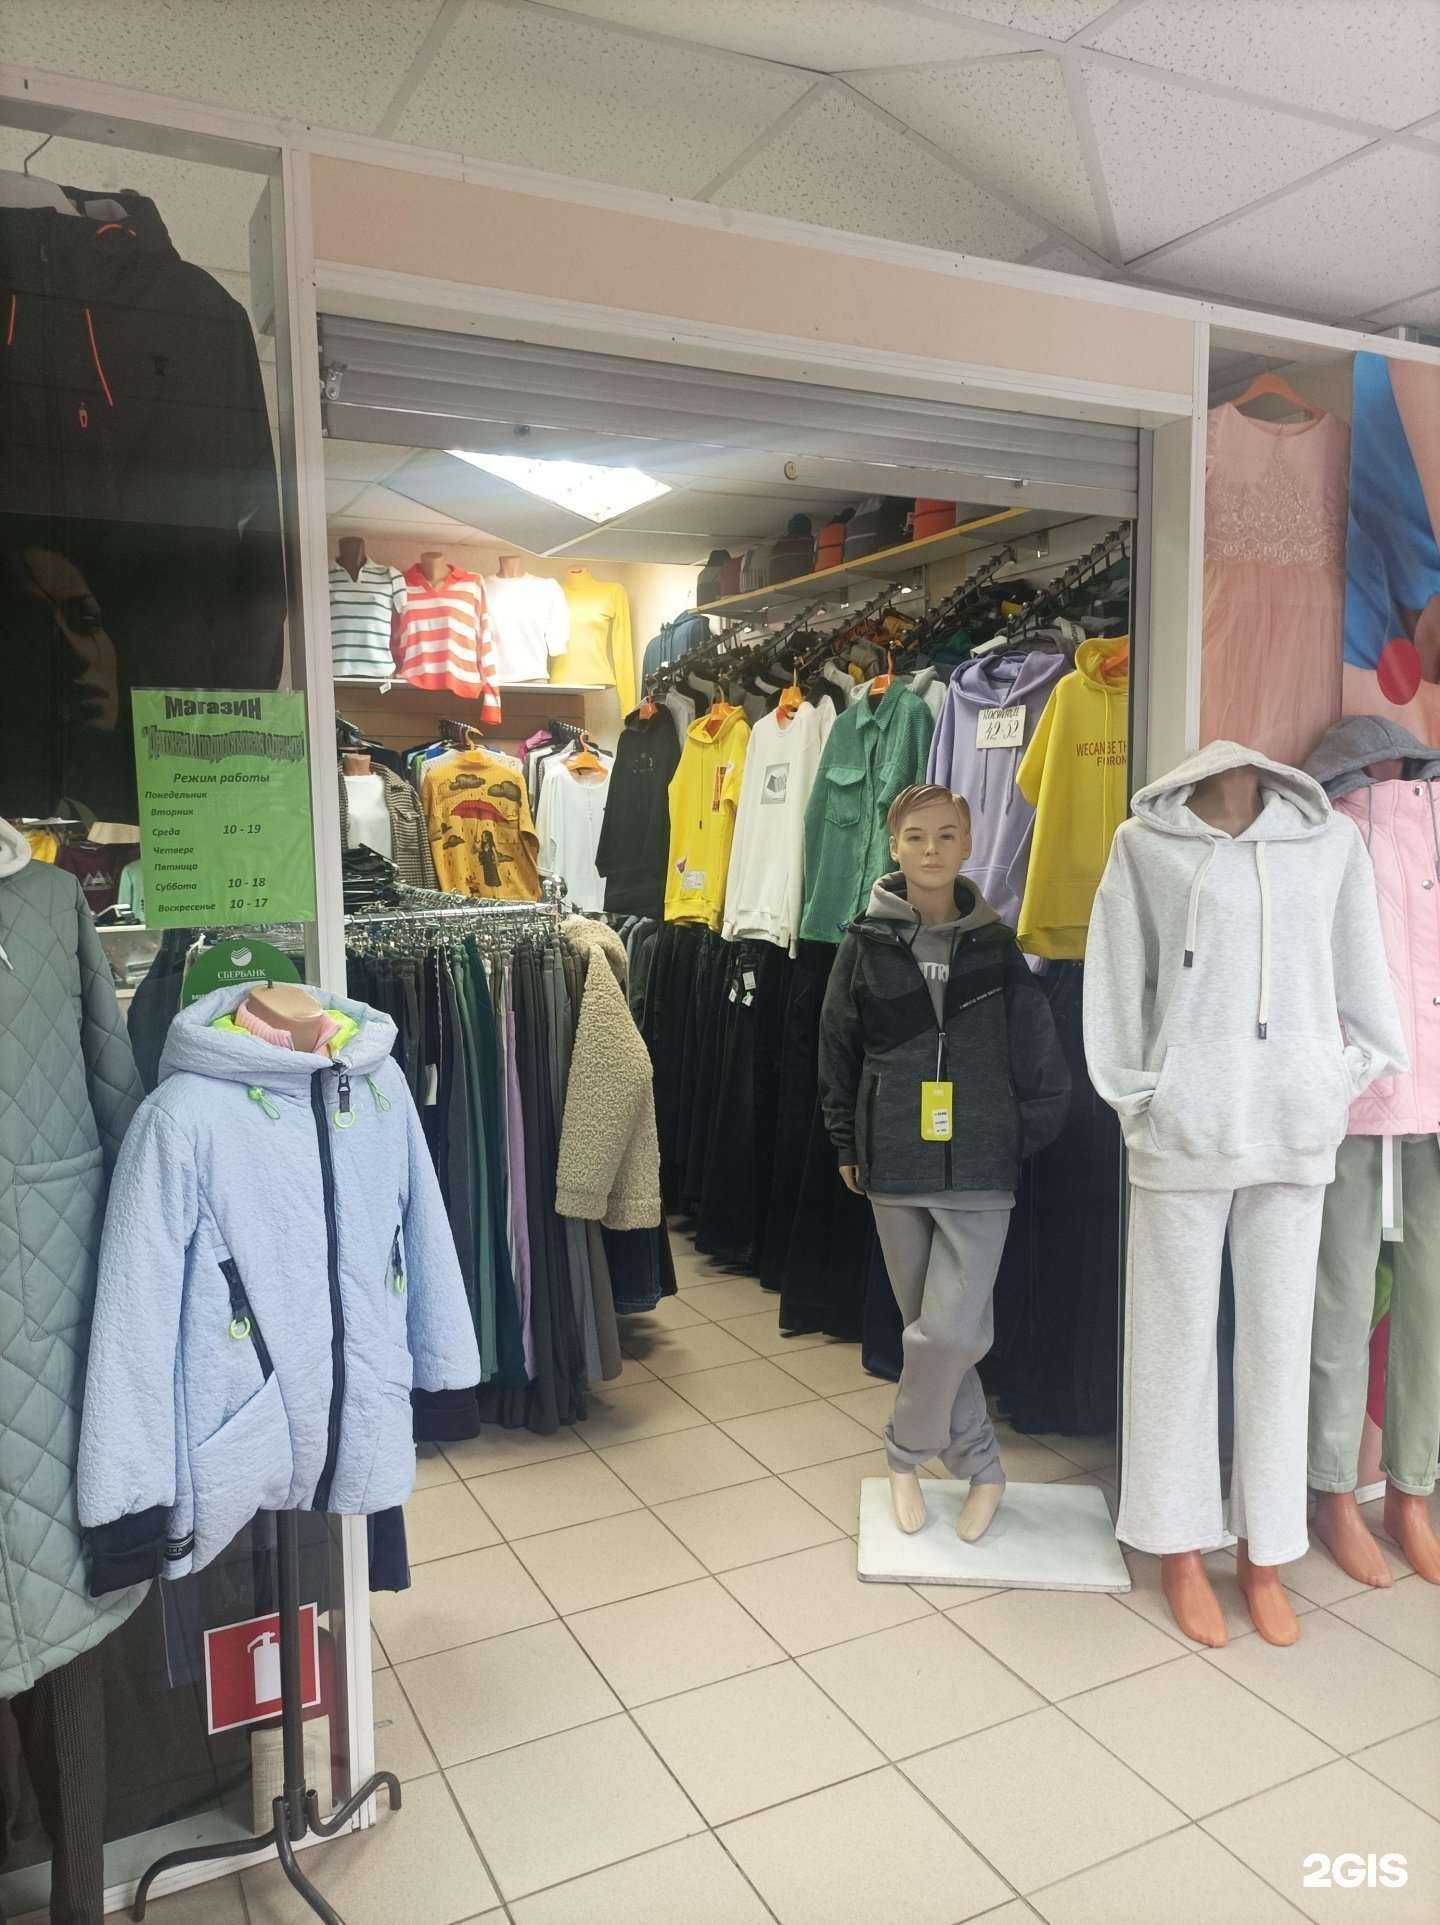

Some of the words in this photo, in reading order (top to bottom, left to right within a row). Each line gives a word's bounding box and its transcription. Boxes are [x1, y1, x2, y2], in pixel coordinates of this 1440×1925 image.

[165, 695, 262, 720] Магазин
[173, 773, 217, 783] Режим
[220, 772, 270, 785] работы
[144, 790, 208, 799] Понедельник
[151, 808, 194, 817] Вторник
[152, 827, 181, 838] Среда
[223, 824, 237, 835] 10
[247, 824, 262, 834] 19
[153, 846, 194, 856] Четверг
[154, 863, 198, 872] Пятница
[155, 882, 197, 893] Суббота
[228, 878, 242, 889] 10
[252, 877, 266, 888] 18
[158, 903, 216, 913] Воскресенье
[229, 899, 244, 909] 10
[255, 898, 268, 908] 17
[217, 968, 267, 979] СБЕРБАНК
